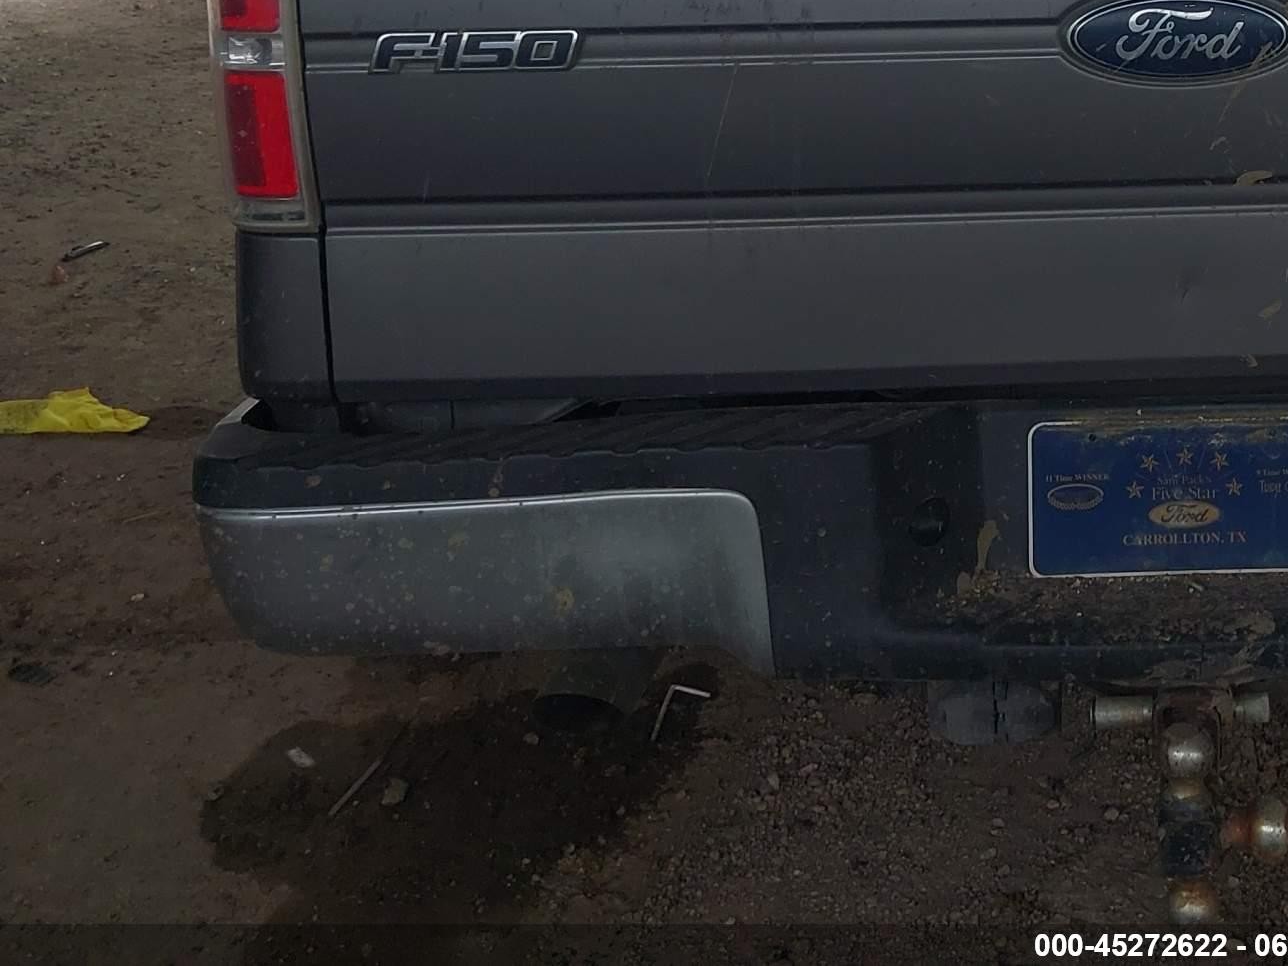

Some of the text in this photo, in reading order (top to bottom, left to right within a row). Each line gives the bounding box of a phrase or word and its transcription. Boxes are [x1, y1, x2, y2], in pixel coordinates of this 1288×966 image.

[1116, 7, 1245, 59] Ford
[369, 29, 579, 73] F-150
[1151, 486, 1218, 501] Five Star
[1160, 504, 1210, 523] Ford
[1123, 530, 1247, 546] CARROLLTON, TX
